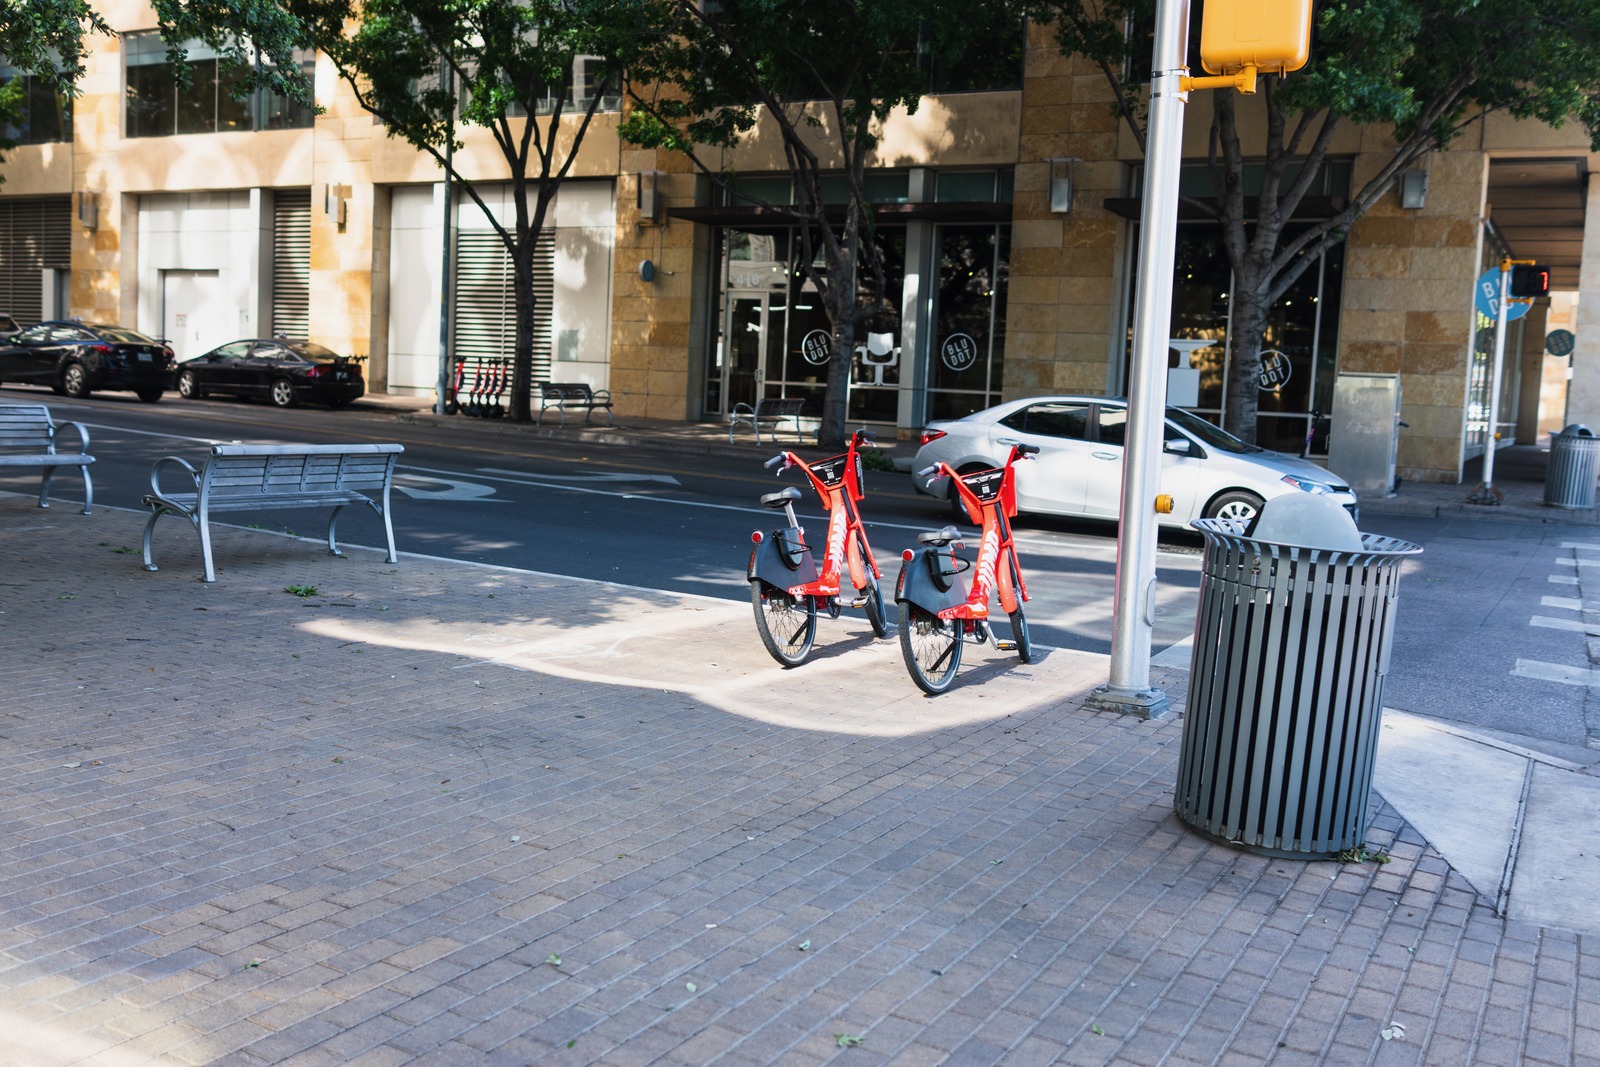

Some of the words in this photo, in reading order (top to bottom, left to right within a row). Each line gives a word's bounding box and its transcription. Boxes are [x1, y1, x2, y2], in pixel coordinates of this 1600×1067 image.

[806, 334, 827, 351] BLU
[946, 338, 969, 356] BLU
[810, 344, 830, 361] DOT
[950, 348, 972, 366] DOT
[1260, 367, 1285, 386] DOT
